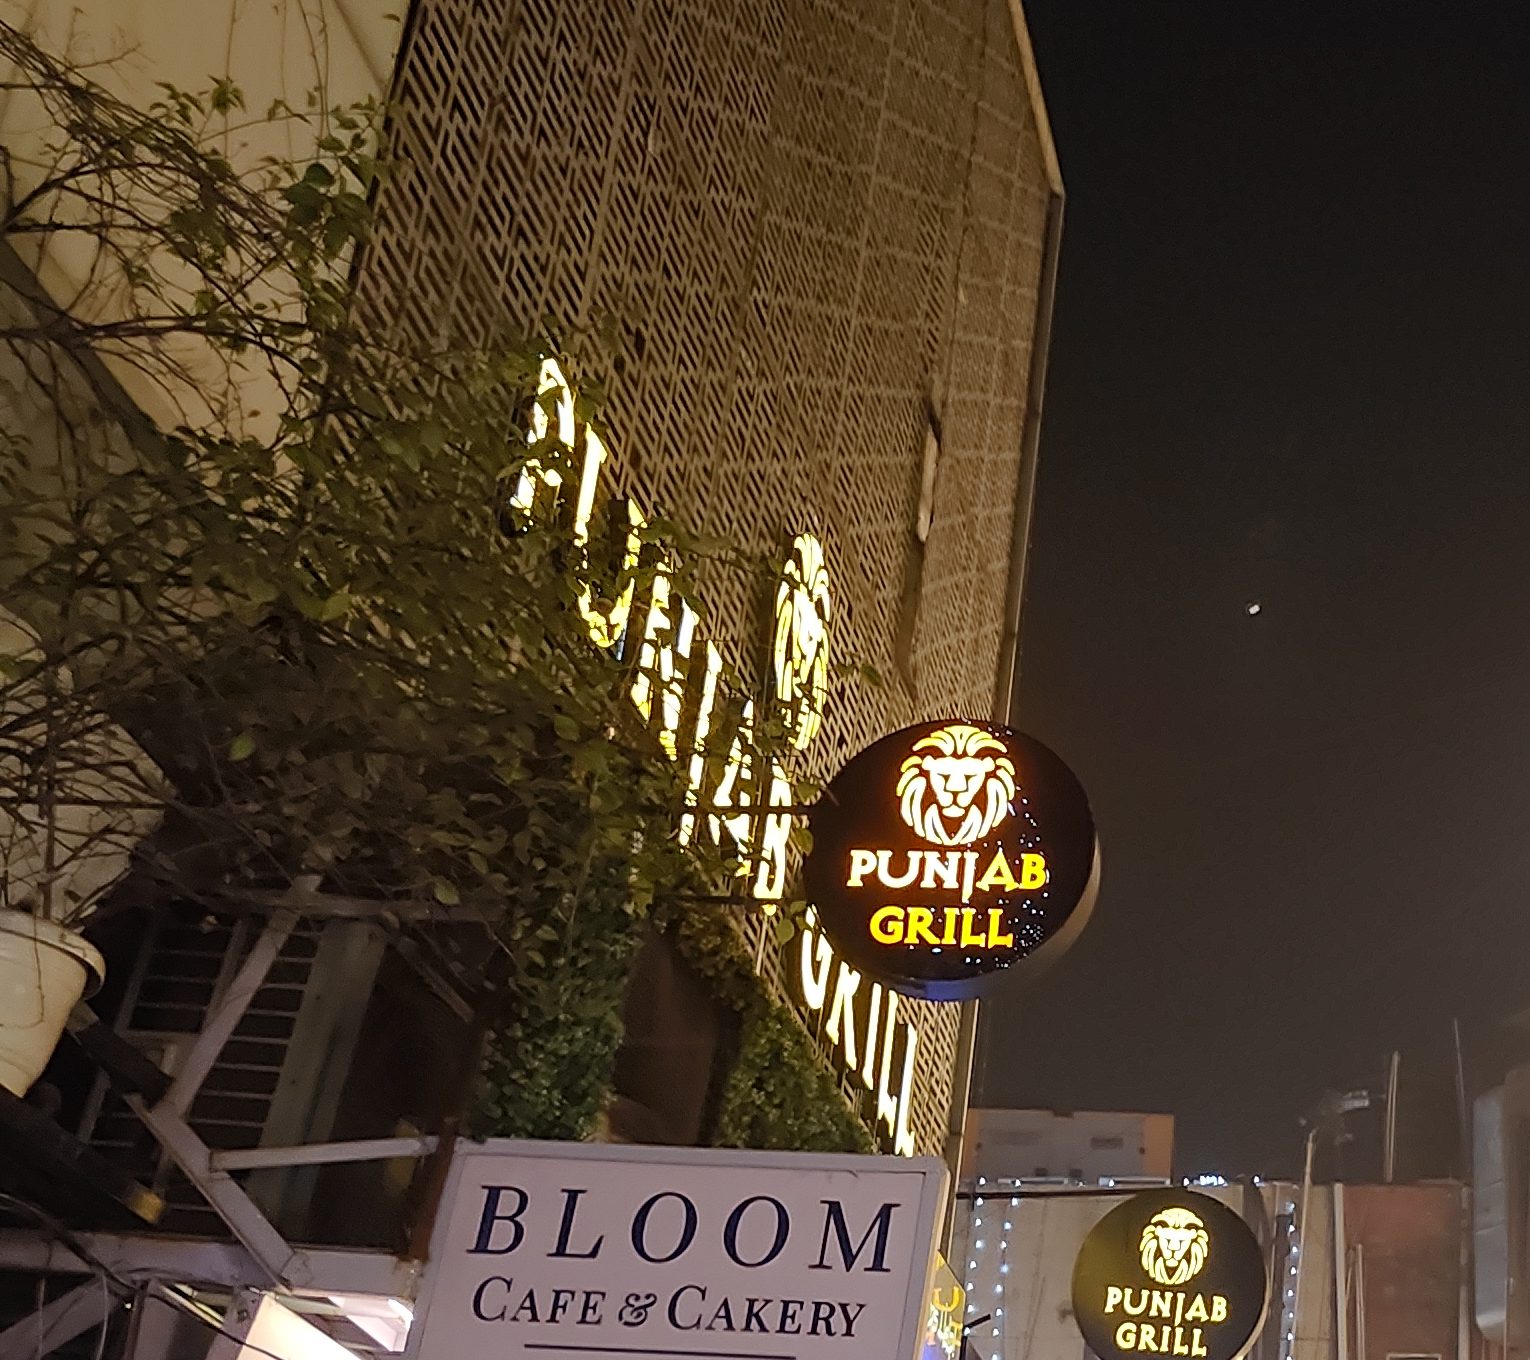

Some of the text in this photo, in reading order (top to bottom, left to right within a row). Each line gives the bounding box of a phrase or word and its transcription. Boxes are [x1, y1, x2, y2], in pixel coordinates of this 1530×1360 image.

[846, 849, 1047, 903] PUNJAB
[869, 906, 1013, 949] GRILL
[466, 1185, 902, 1274] BLOOM
[617, 1292, 658, 1328] &
[1104, 1286, 1227, 1327] PUNJAB
[1116, 1322, 1207, 1357] GRILL
